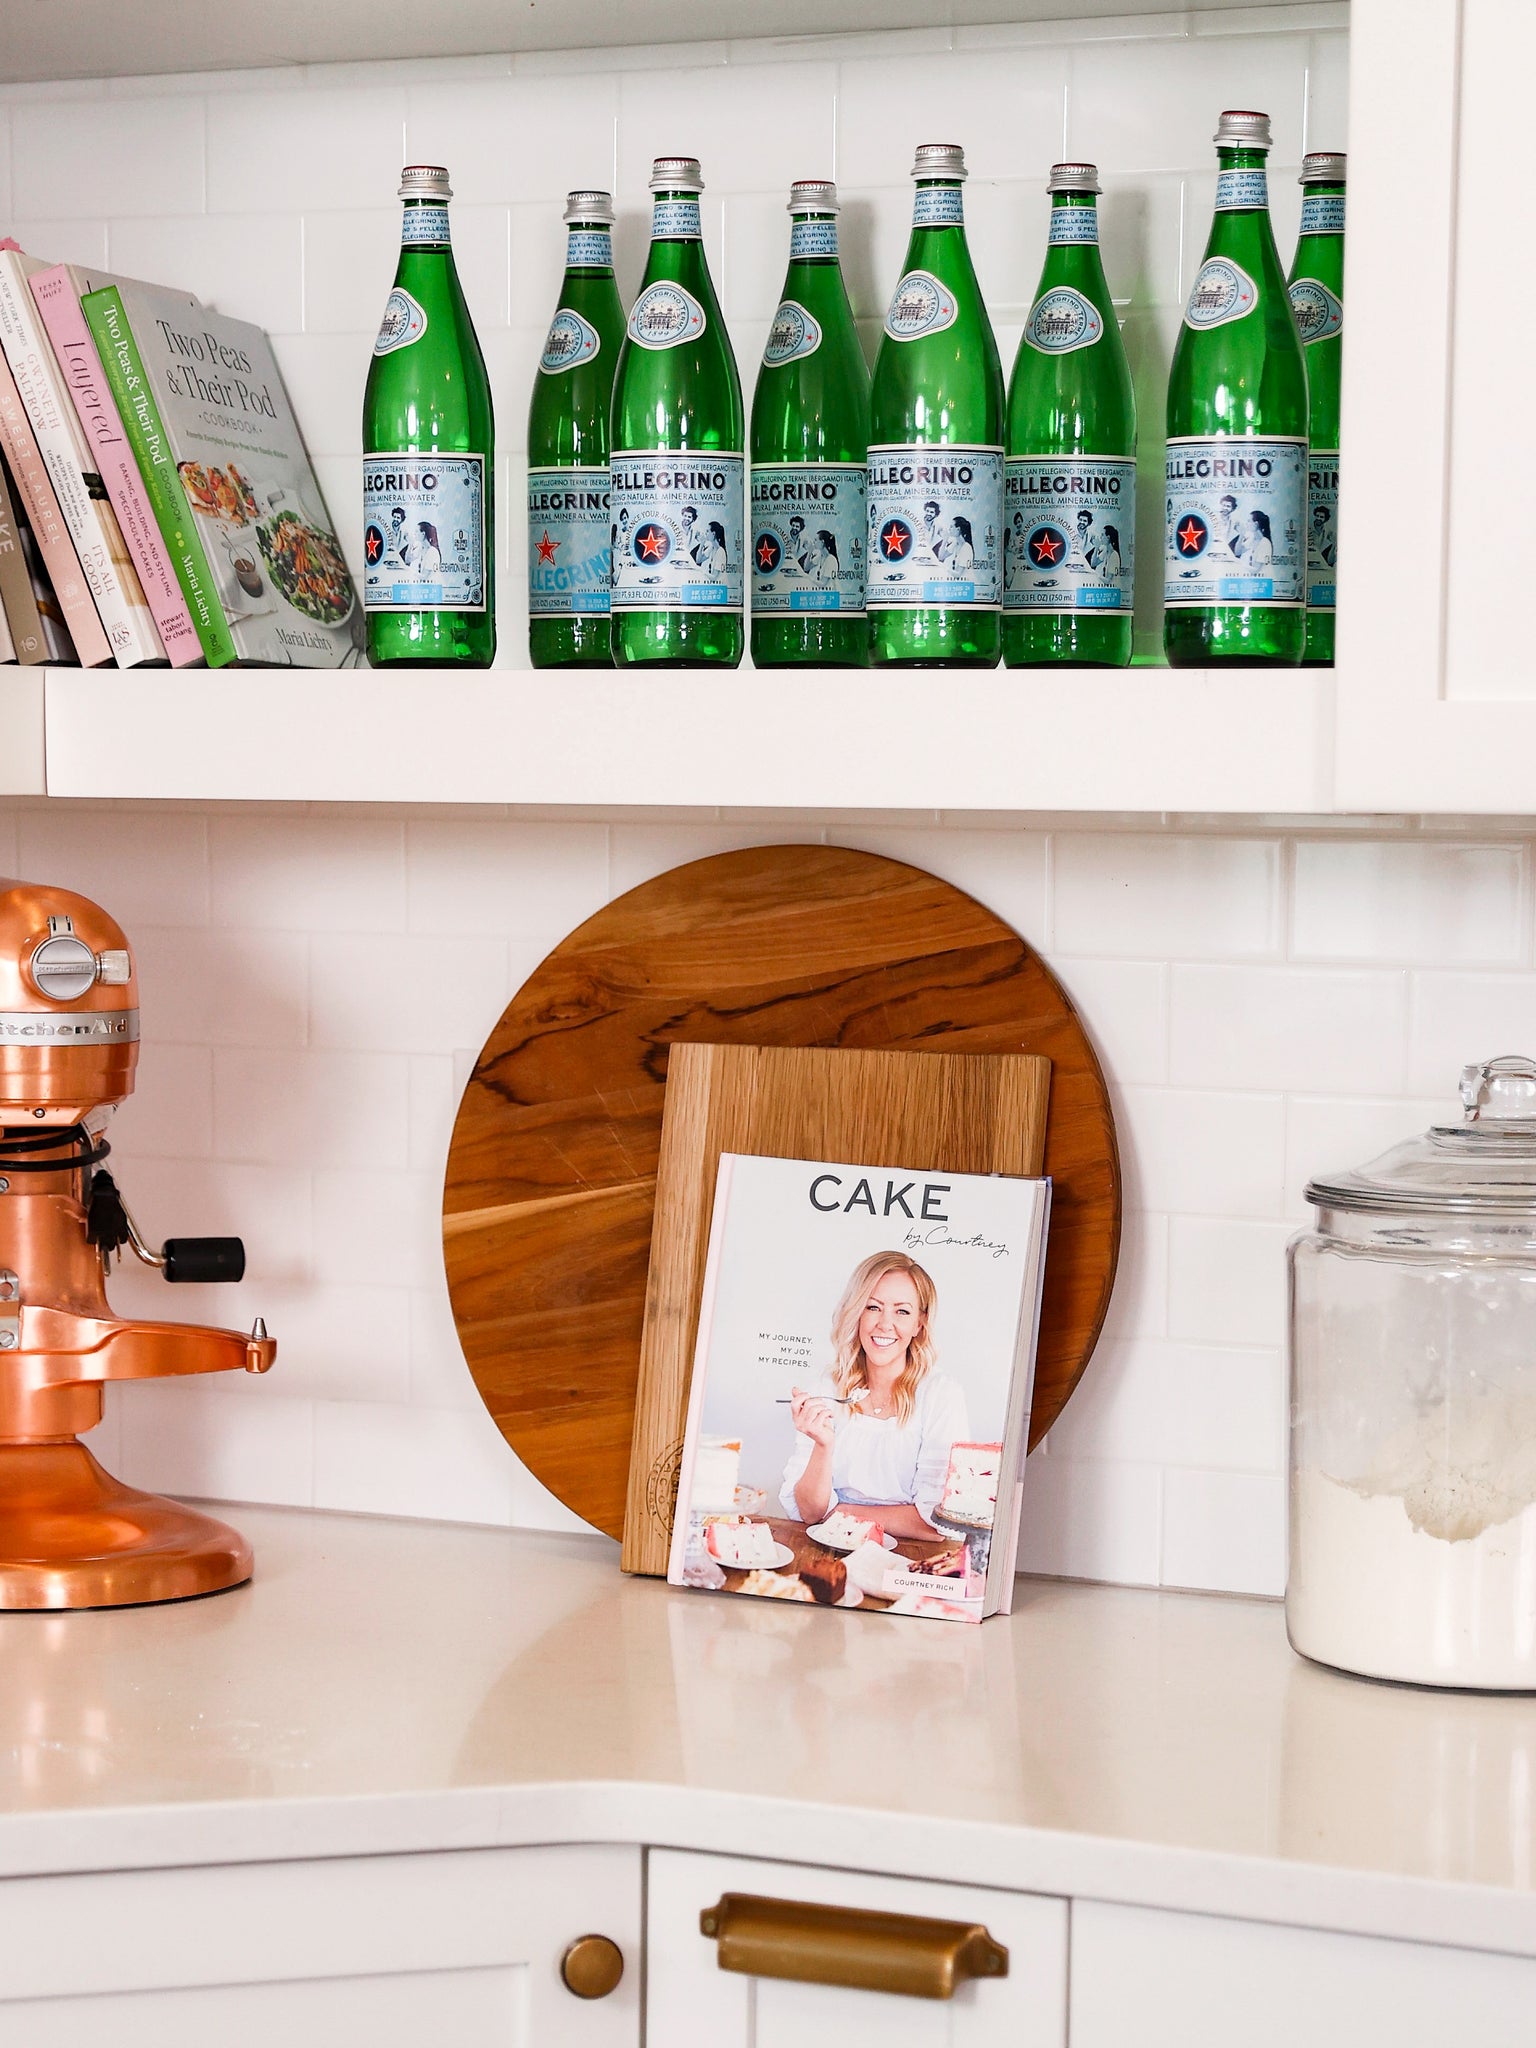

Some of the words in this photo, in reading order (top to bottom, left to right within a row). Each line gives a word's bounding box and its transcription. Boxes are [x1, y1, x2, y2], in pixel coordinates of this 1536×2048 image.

[103, 304, 121, 339] Two
[114, 340, 134, 375] Peas
[156, 320, 205, 362] Two
[203, 332, 252, 374] Peas
[27, 353, 60, 429] GWYNETH
[63, 342, 122, 448] Layered
[127, 376, 140, 391] &
[166, 369, 183, 396] &
[177, 365, 235, 408] Their
[233, 379, 277, 419] Pod
[15, 362, 47, 430] PALTROW
[132, 391, 154, 432] Their
[146, 434, 168, 465] Pod
[2, 396, 31, 461] SWEET
[28, 471, 60, 545] LAUREL
[364, 473, 438, 492] LEGRINO
[611, 472, 725, 492] PELLEGRINO
[160, 468, 182, 523] COOKBOOK
[408, 494, 436, 502] WATER
[626, 493, 658, 501] NATURAL
[700, 493, 724, 501] WATER
[944, 488, 971, 496] WATER
[1006, 476, 1120, 496] PELLEGRINO
[808, 503, 835, 511] WATER
[1021, 497, 1055, 505] NATURAL
[1057, 497, 1093, 505] MINERAL
[1096, 497, 1119, 506] WATER
[553, 512, 586, 520] MINERAL
[589, 512, 610, 520] WATE
[118, 462, 136, 498] BAKING,
[132, 498, 151, 541] BUILDING,
[149, 542, 159, 560] AND
[156, 561, 173, 597] STYLING
[118, 490, 144, 550] SPECTACULAR
[140, 550, 154, 579] CAKES
[82, 553, 103, 596] GOOD
[100, 572, 116, 596] ALL
[181, 555, 199, 590] Maria
[194, 590, 211, 627] Lichty
[1049, 593, 1063, 602] (750
[161, 612, 185, 627] stewart
[274, 627, 305, 647] Maria
[0, 1018, 128, 1036] itchenAid
[809, 1174, 952, 1222] CAKE
[902, 1227, 924, 1249] by
[924, 1225, 1009, 1259] Courtney
[772, 1334, 813, 1344] JOURNEY.
[771, 1357, 811, 1368] RECIPES.
[894, 1579, 935, 1589] COURTNEY
